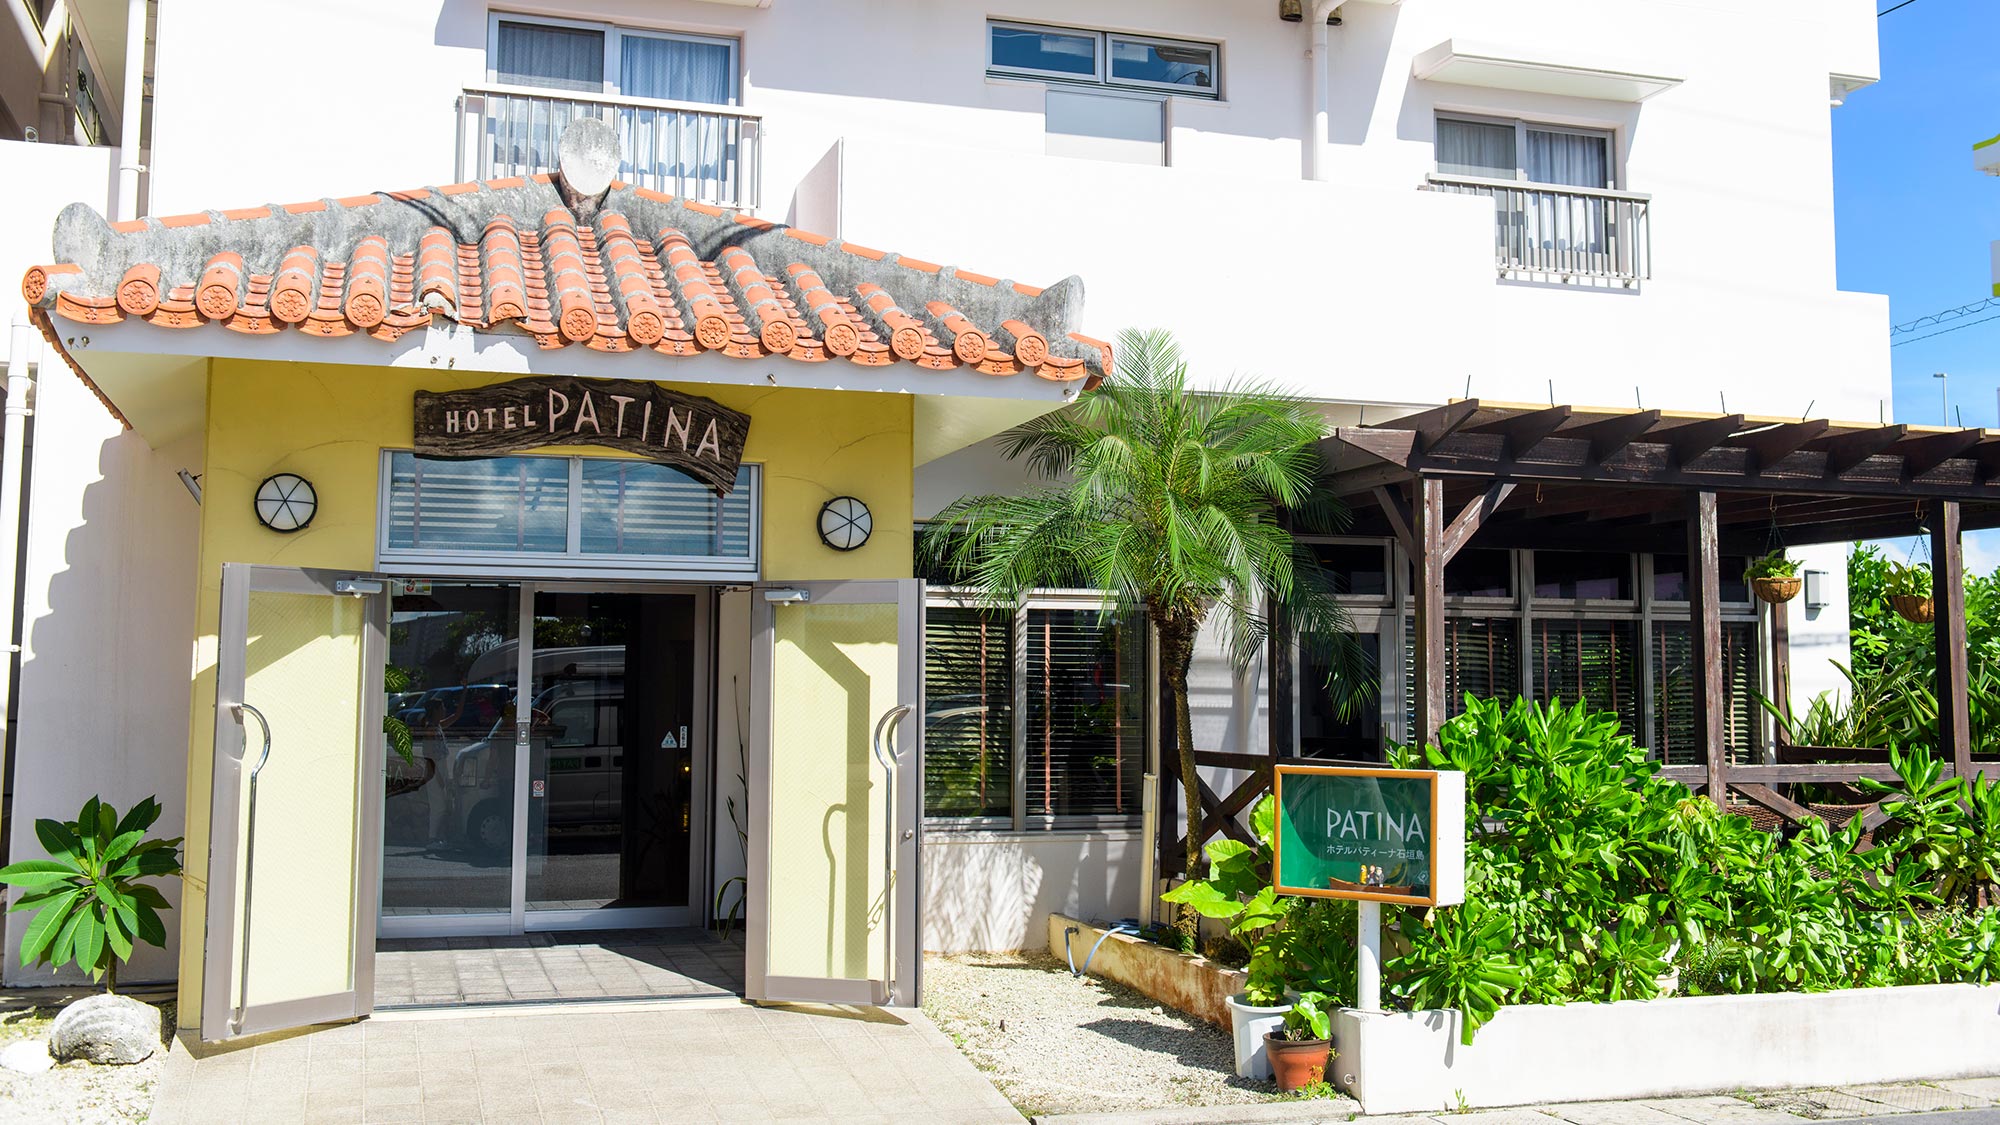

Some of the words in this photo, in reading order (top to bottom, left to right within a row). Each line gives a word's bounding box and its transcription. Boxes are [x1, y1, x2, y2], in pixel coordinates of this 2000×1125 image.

[446, 405, 536, 432] HOTEL
[549, 388, 720, 461] PATINA
[1327, 808, 1425, 843] PATINA
[1326, 844, 1425, 860] ホテルパティーナ石垣島
